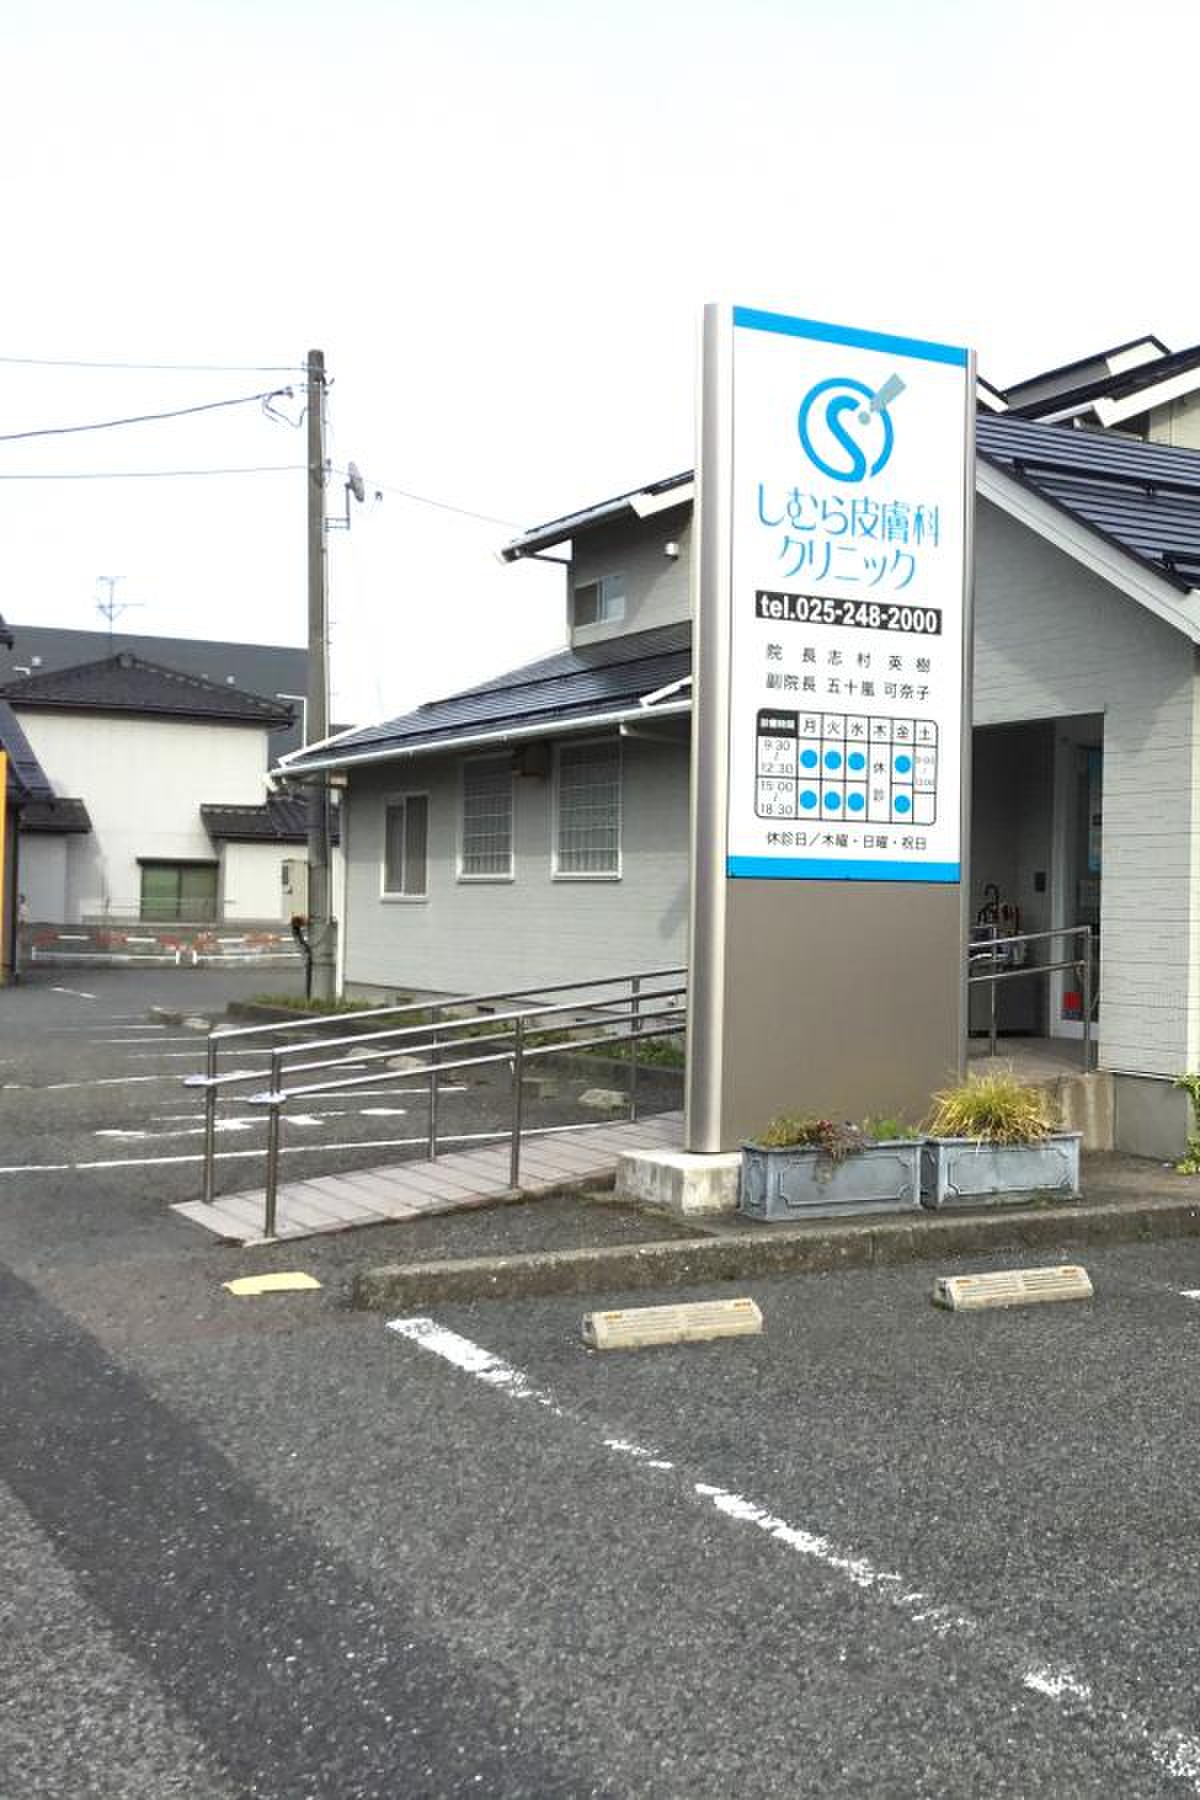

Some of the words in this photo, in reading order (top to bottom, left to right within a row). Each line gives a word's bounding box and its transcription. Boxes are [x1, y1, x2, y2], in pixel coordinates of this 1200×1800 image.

[758, 482, 939, 548] しむら皮膚科
[779, 535, 916, 590] クリニック
[760, 595, 938, 633] tel.025-248-2000
[803, 719, 817, 734] 月
[826, 721, 841, 736] 火
[850, 722, 864, 737] 水
[873, 724, 888, 739] 木
[896, 725, 910, 740] 金
[919, 726, 932, 741] 土
